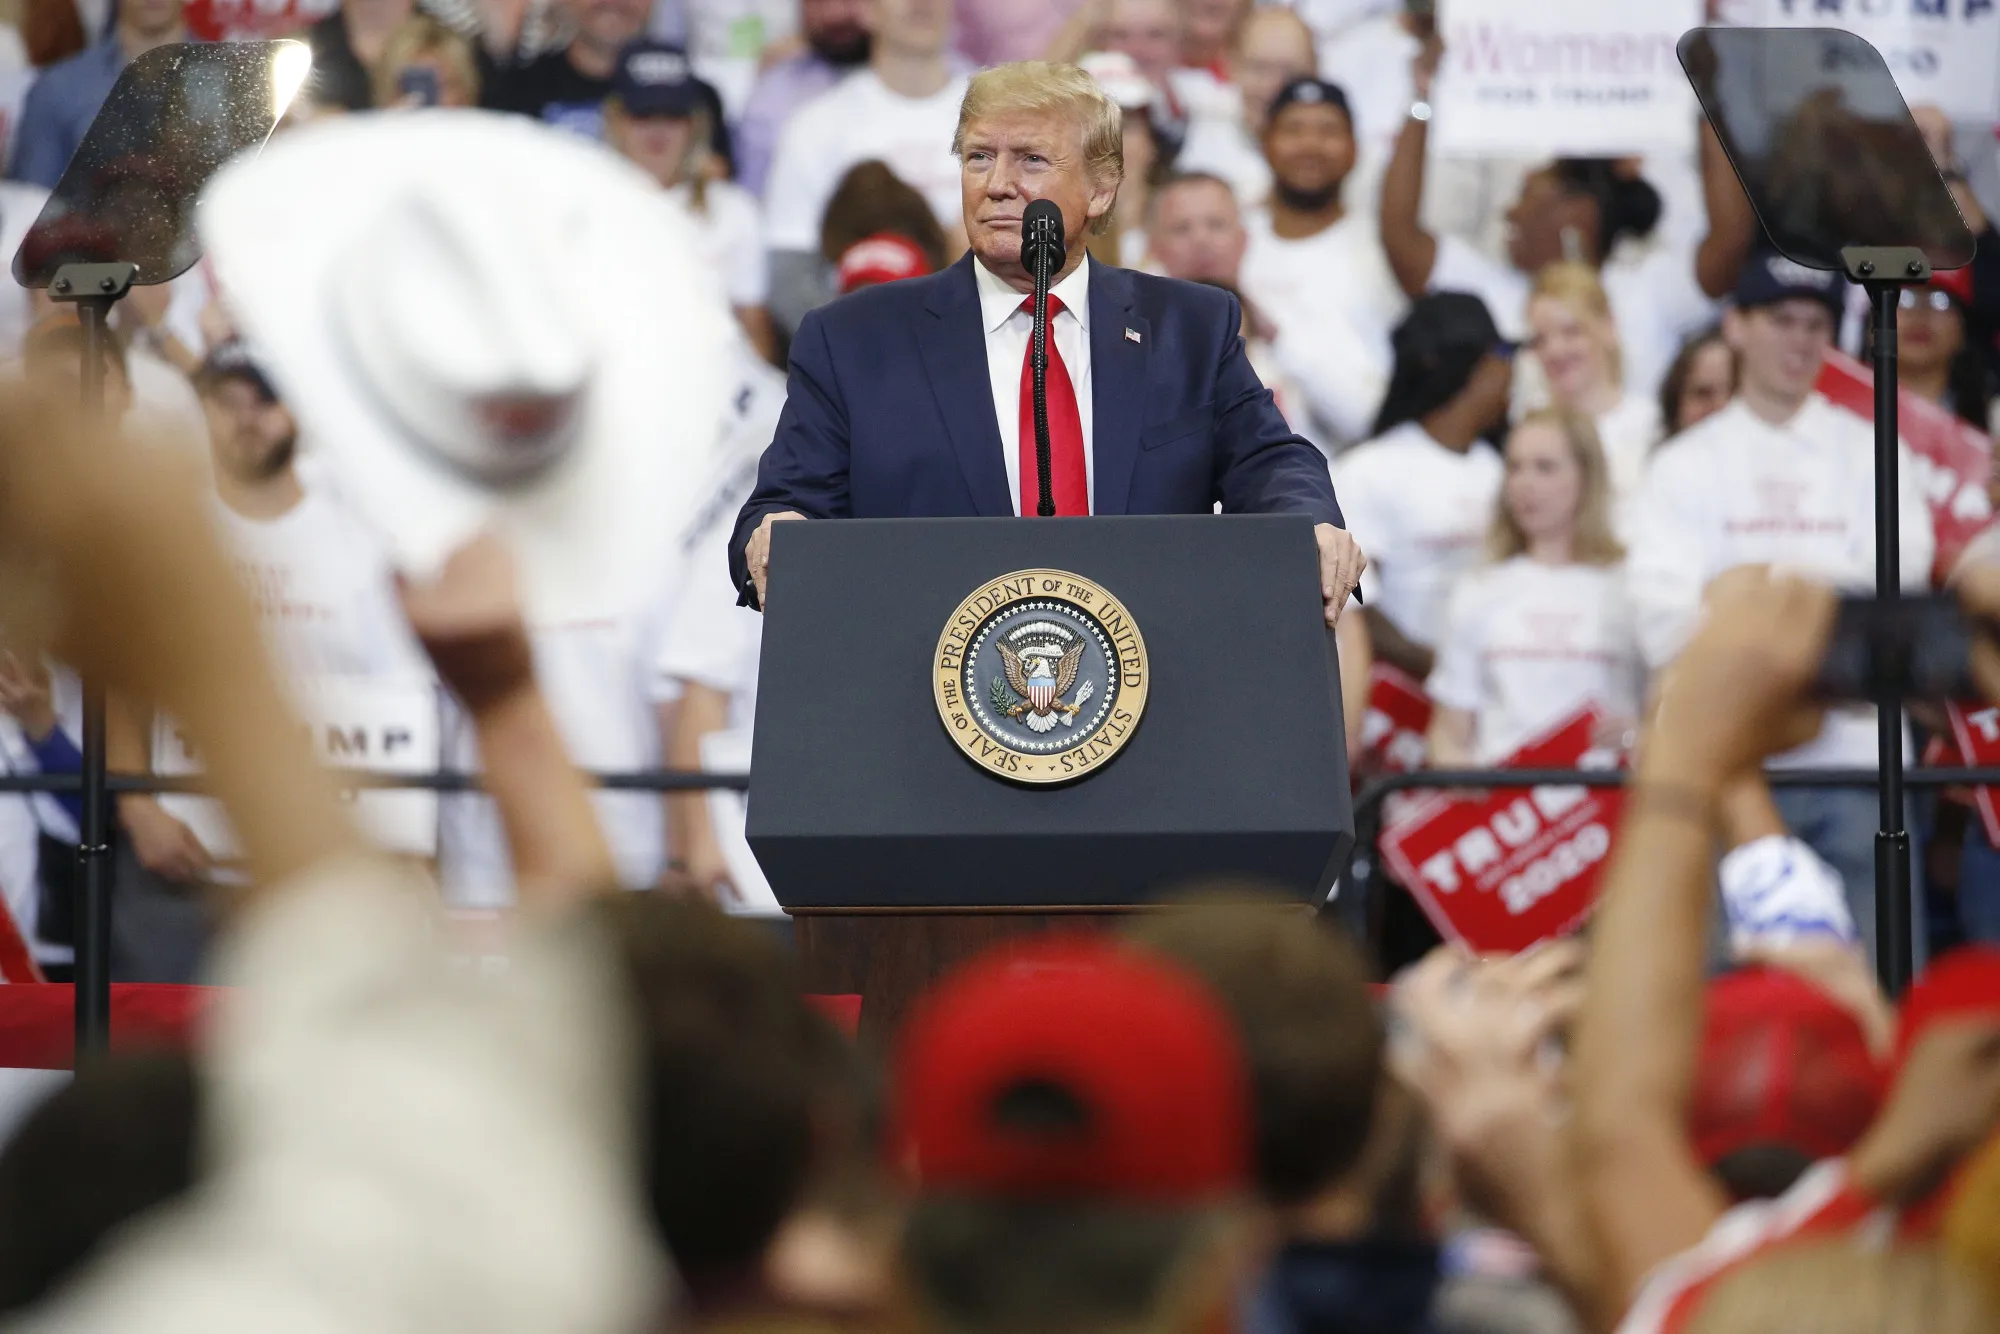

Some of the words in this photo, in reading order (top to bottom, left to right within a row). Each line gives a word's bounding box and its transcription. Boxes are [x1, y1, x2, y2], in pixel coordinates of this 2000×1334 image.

[1042, 579, 1062, 592] OF
[1067, 583, 1094, 604] THE
[940, 577, 1036, 671] PRESIDENT
[1097, 601, 1142, 688] UNITED
[943, 678, 959, 709] THE
[951, 711, 969, 731] OF
[1059, 707, 1133, 773] STATES
[967, 727, 1022, 773] SEAL
[1498, 823, 1610, 915] 2020
